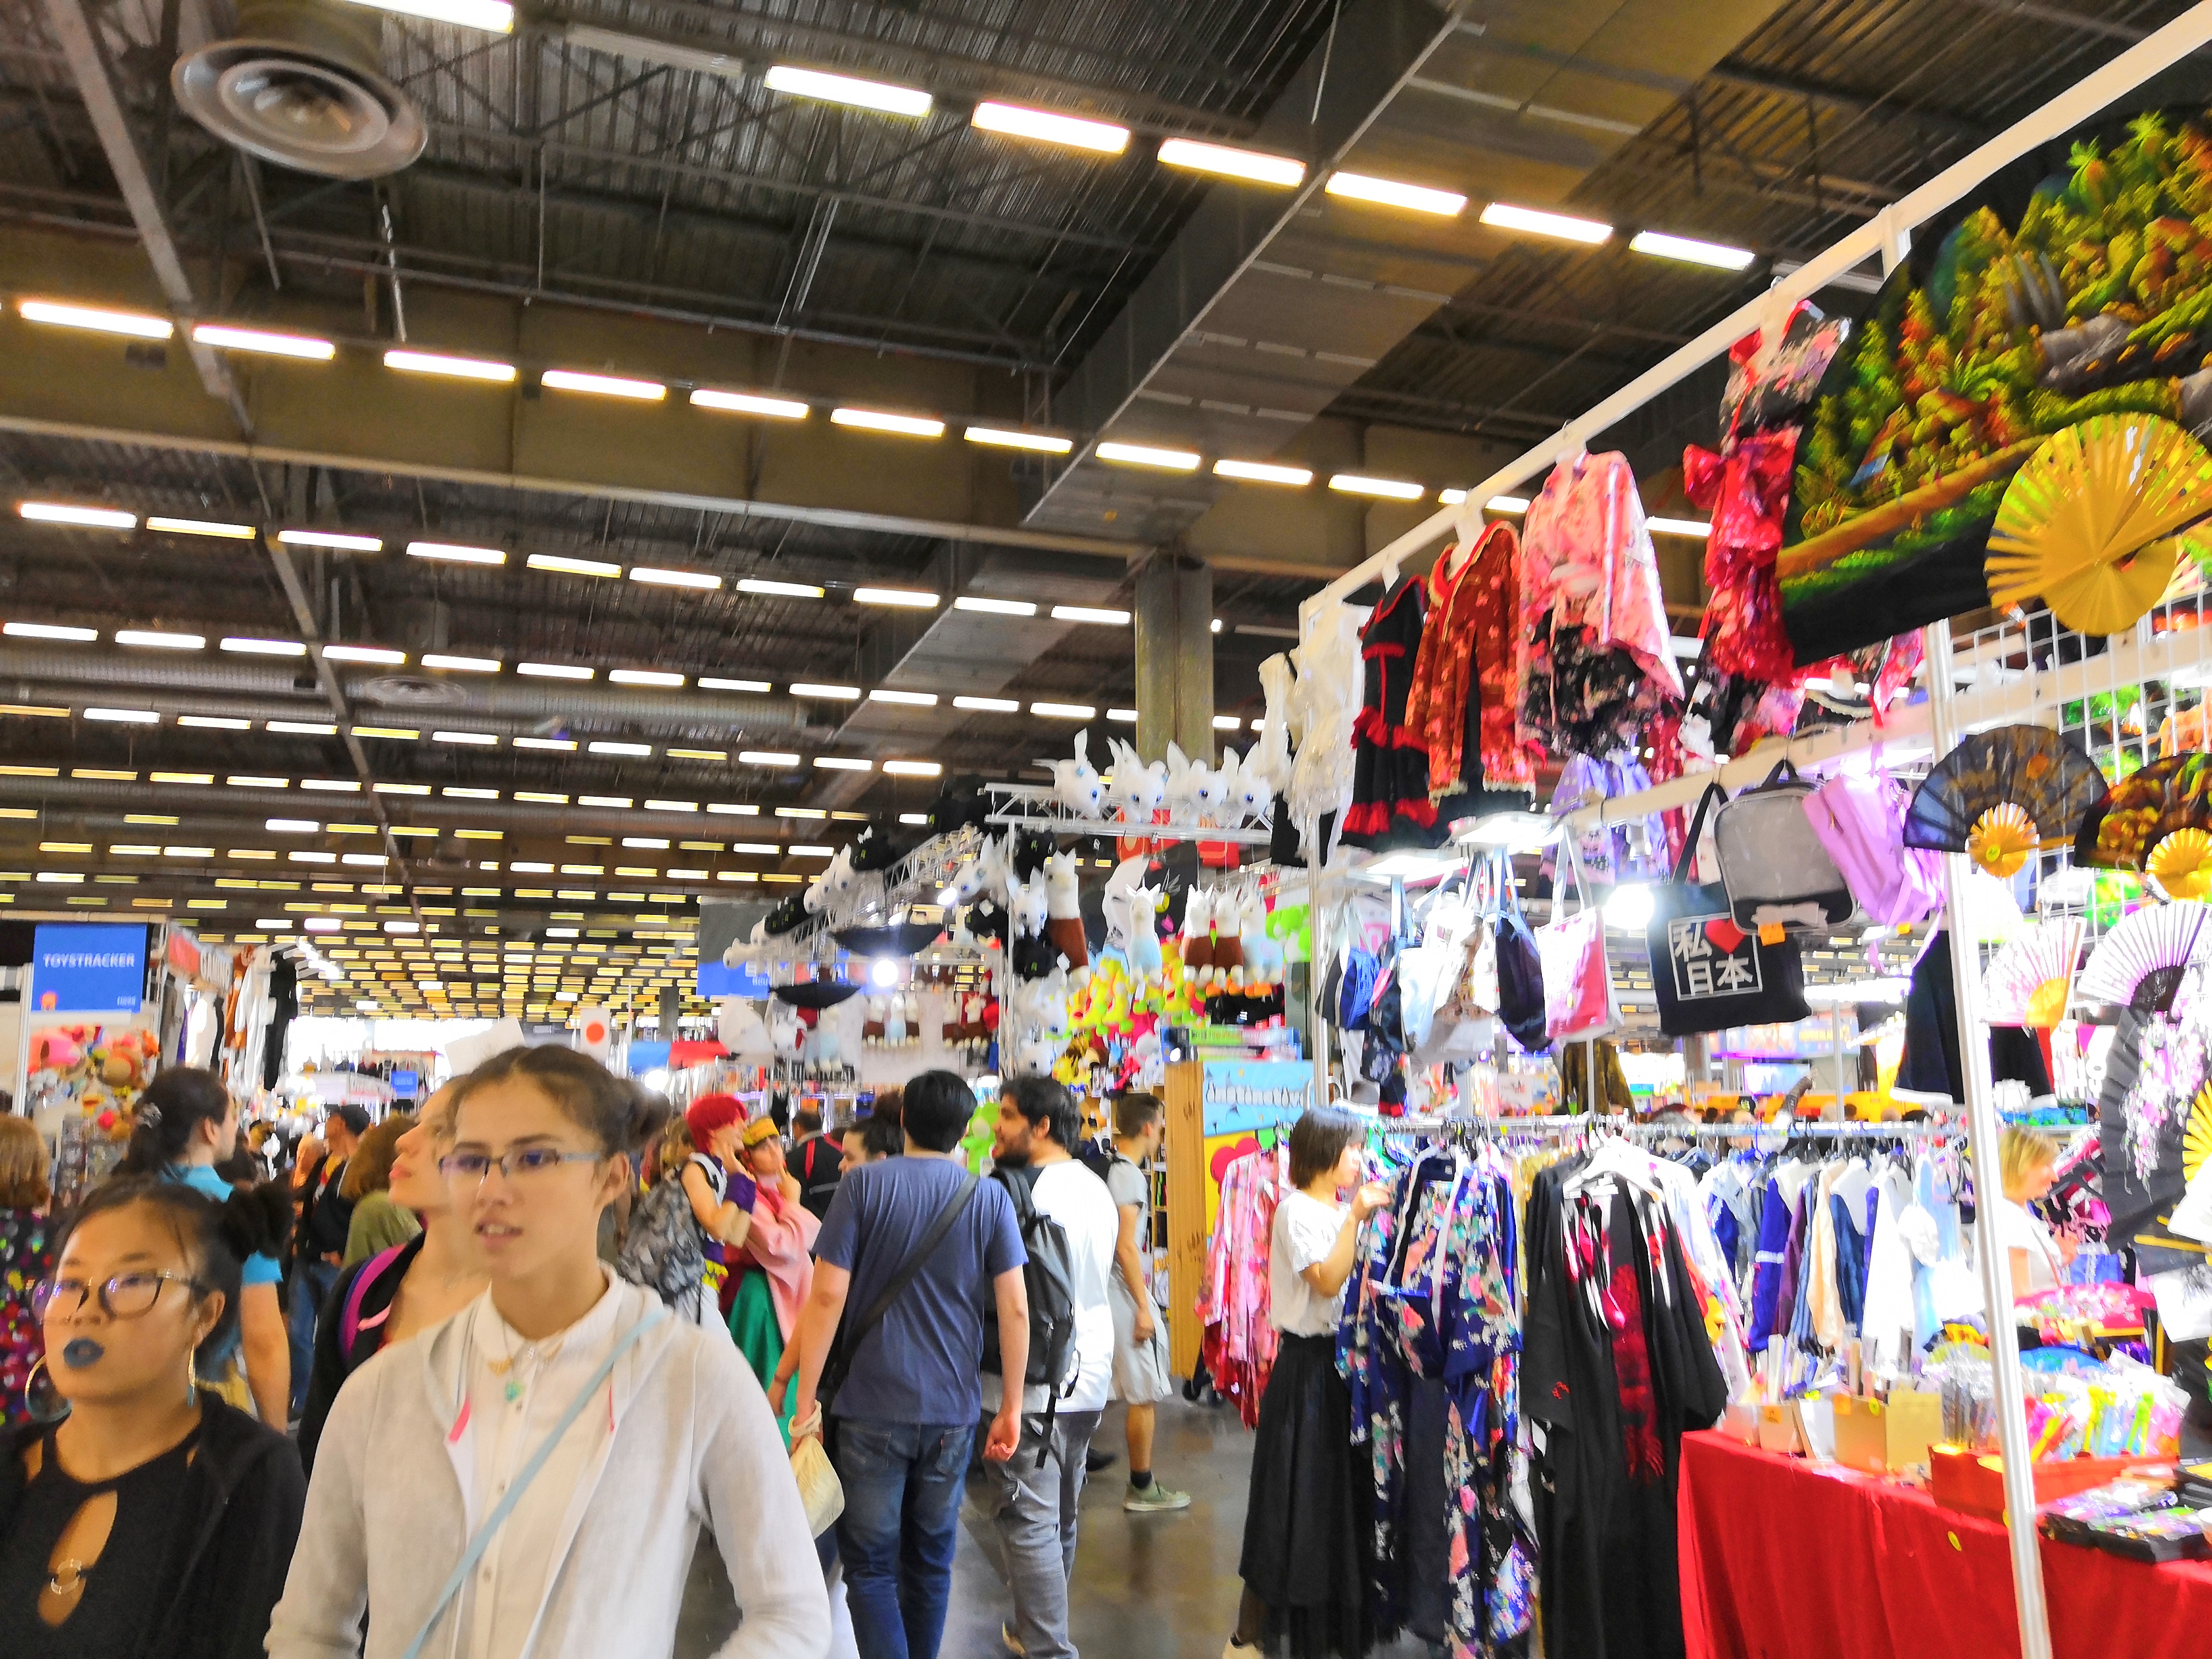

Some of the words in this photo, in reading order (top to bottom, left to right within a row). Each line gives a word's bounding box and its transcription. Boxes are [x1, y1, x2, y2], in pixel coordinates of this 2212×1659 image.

[43, 953, 135, 968] TOYSTRACKER
[1672, 922, 1713, 962] 私
[1688, 954, 1754, 996] 日本
